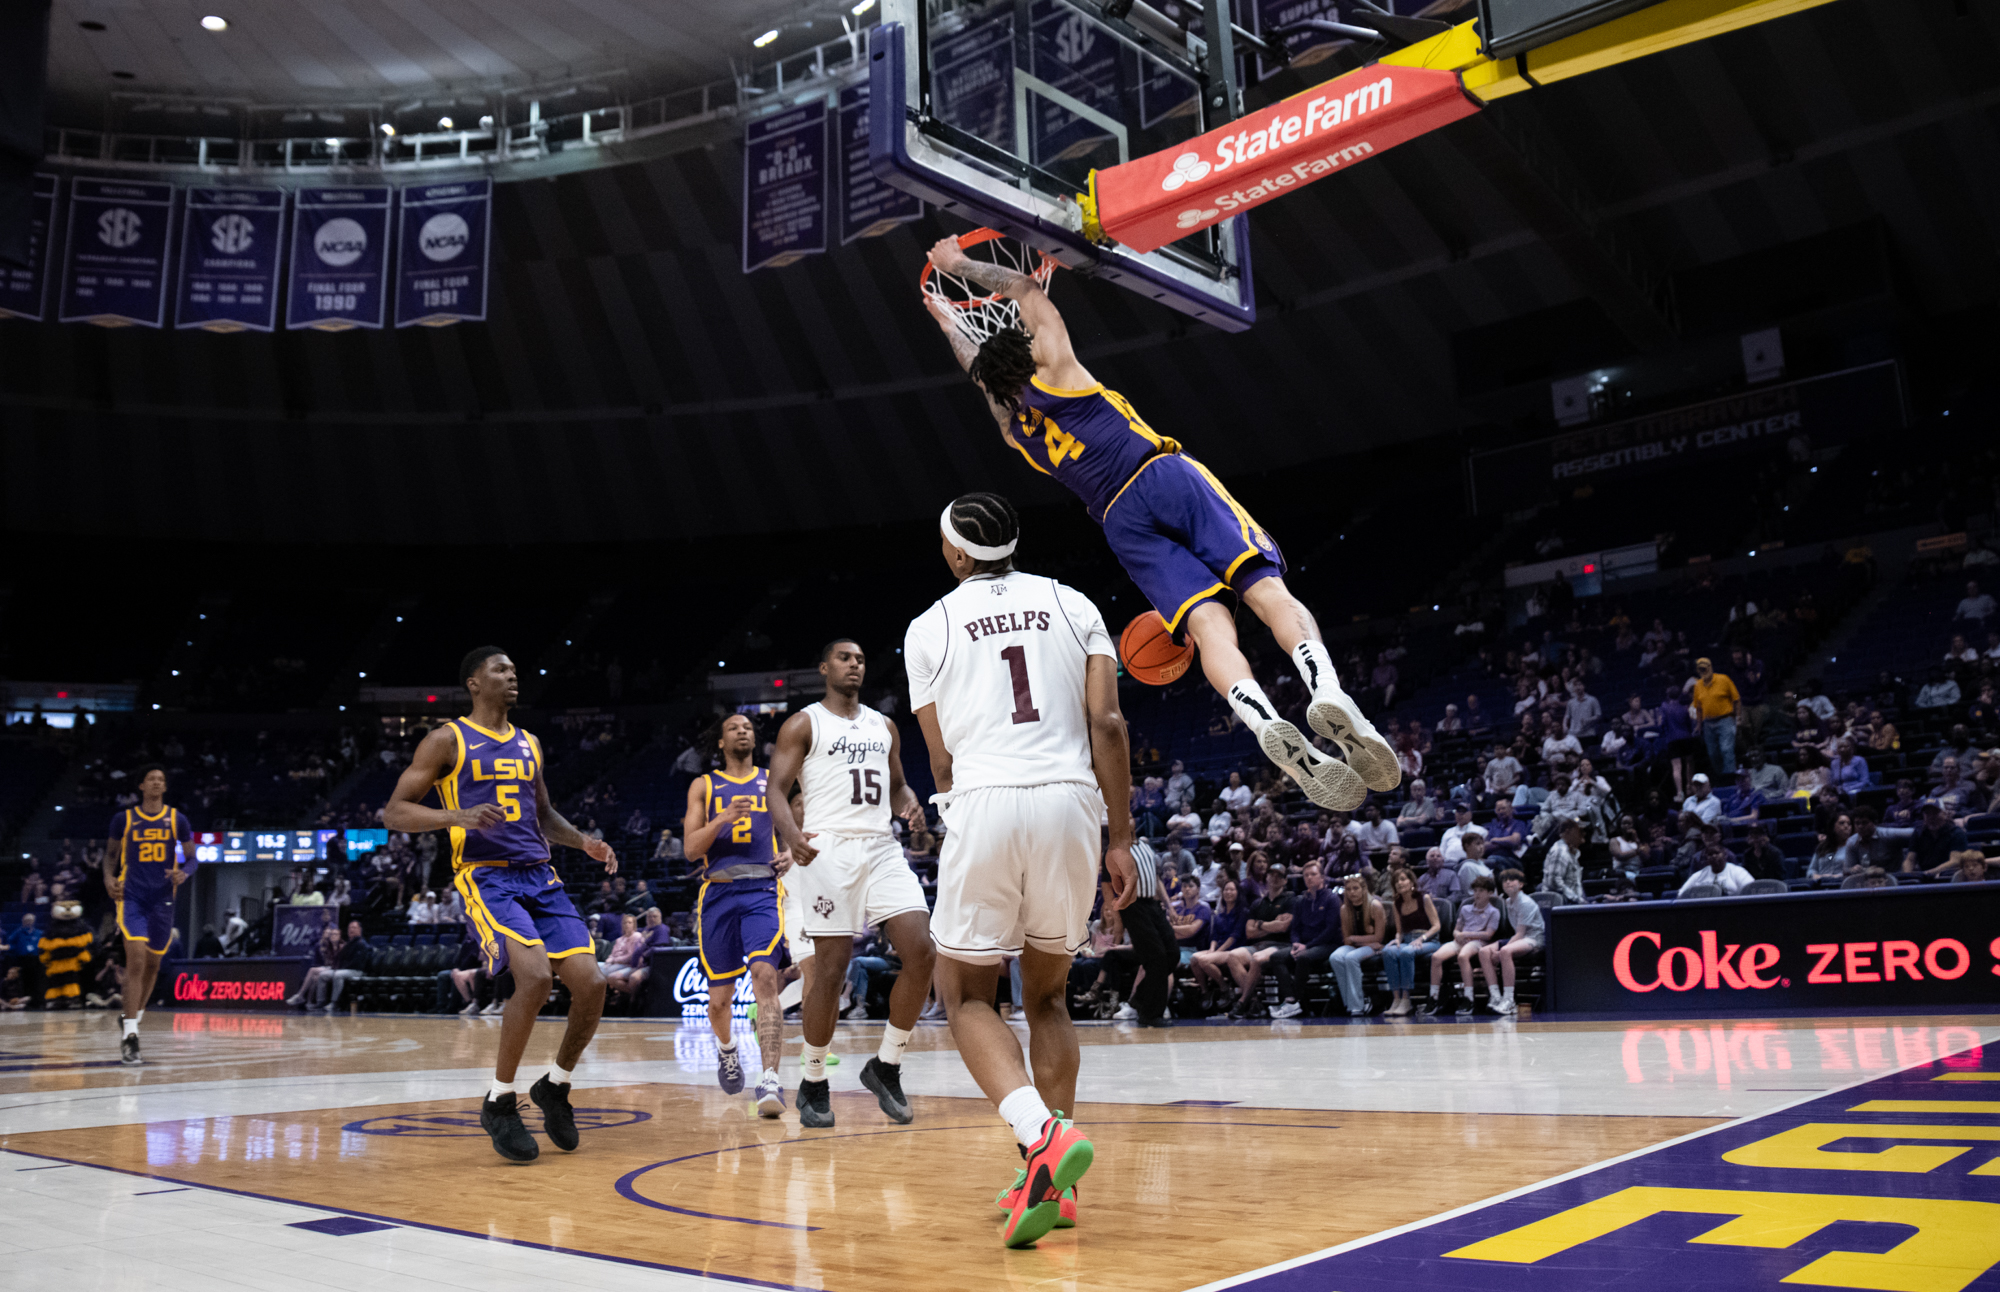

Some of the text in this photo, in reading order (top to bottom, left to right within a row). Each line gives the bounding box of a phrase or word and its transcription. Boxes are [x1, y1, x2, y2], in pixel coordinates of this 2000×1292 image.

[758, 155, 813, 186] BREAUX
[97, 207, 143, 248] SEC
[211, 213, 255, 254] SEC
[319, 240, 365, 253] NCAA
[424, 234, 468, 250] NCAA
[306, 281, 367, 294] FINAL FOUR
[413, 275, 469, 291] FINAL FOUR
[314, 294, 358, 311] 1990
[423, 289, 459, 308] 1991
[1043, 416, 1086, 468] 4
[1552, 410, 1802, 480] ASSEMBLY CENTER
[964, 610, 1051, 642] PHELPS
[1001, 645, 1040, 725] 1
[828, 736, 886, 764] Aggies
[471, 758, 535, 781] LSU
[849, 768, 882, 806] 15
[496, 785, 522, 822] 5
[132, 828, 171, 842] LSU
[255, 834, 286, 848] 15.2
[732, 816, 752, 843] 2
[138, 842, 166, 862] 20
[1612, 930, 1782, 993] Coke
[1806, 937, 1971, 984] ZERO
[174, 972, 286, 1001] Coke ZERO SUGAR
